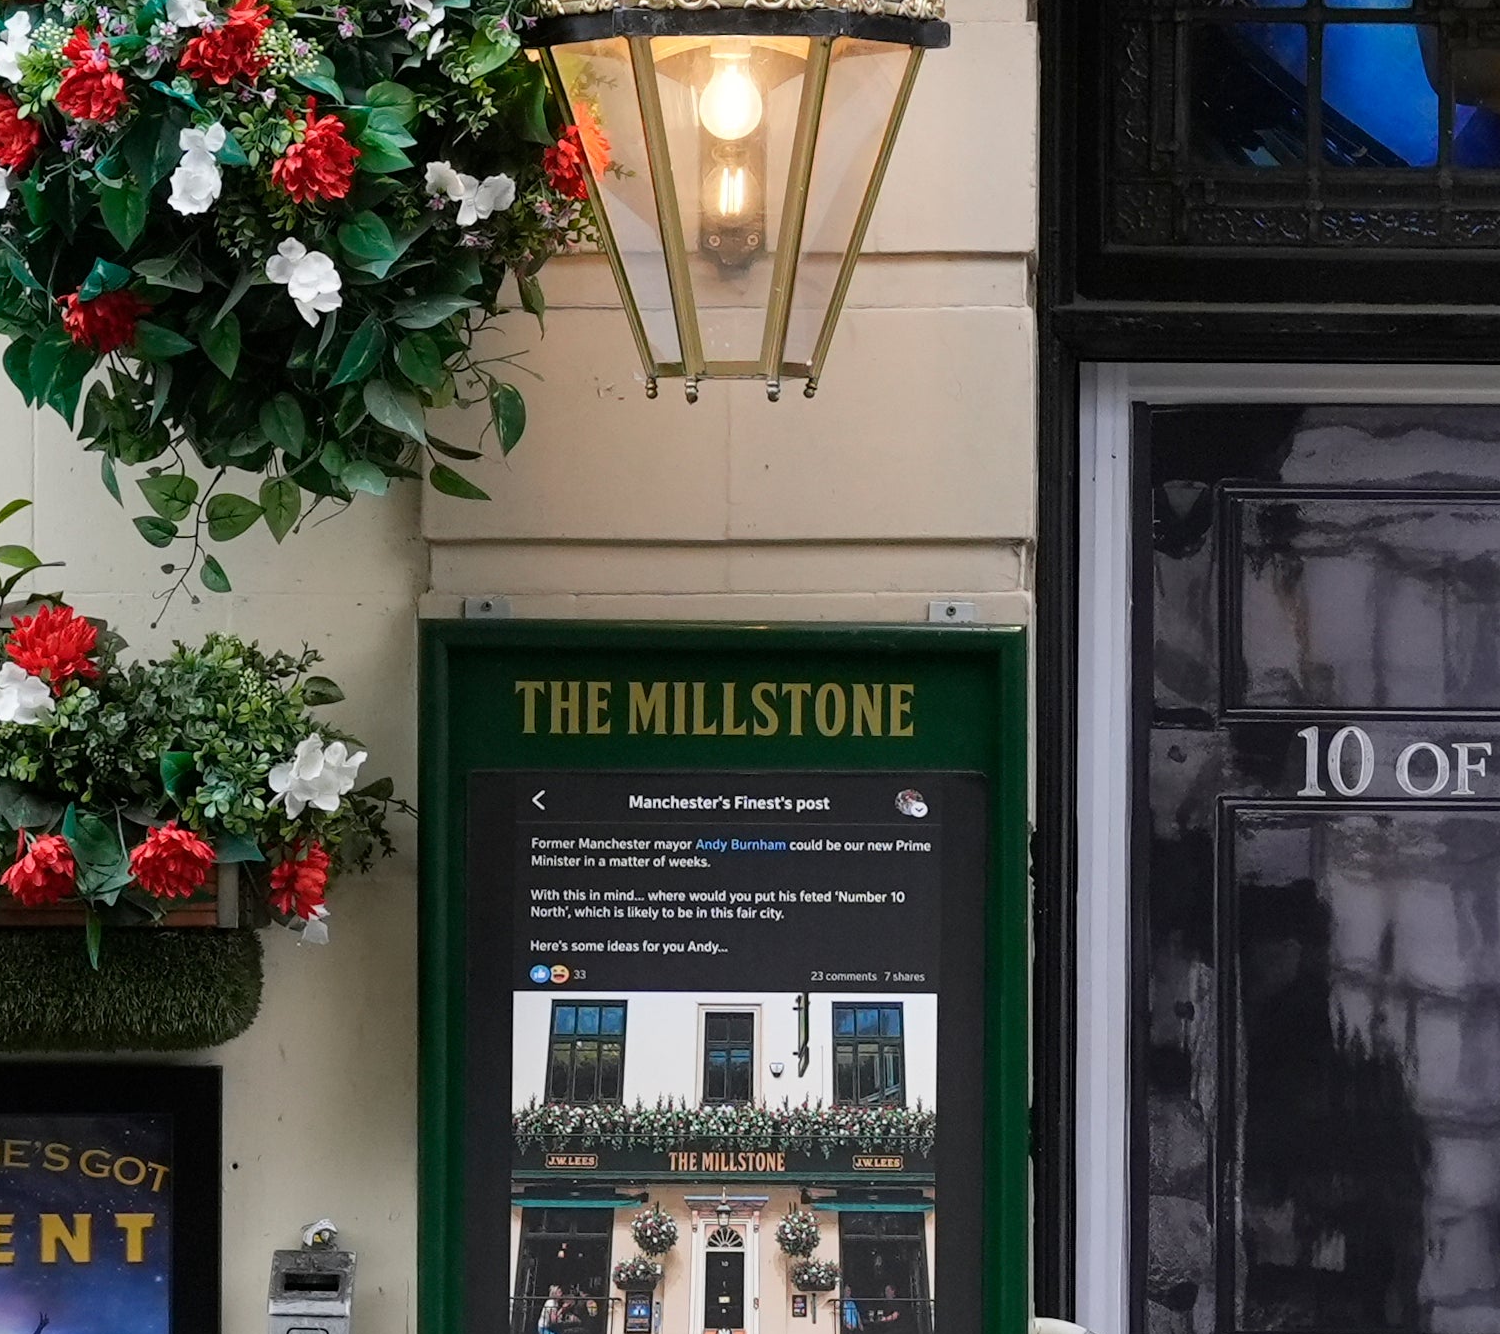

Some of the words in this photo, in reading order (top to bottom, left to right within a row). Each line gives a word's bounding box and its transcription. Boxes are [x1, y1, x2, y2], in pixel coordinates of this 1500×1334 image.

[515, 680, 612, 735] THE
[628, 681, 915, 737] MILLSTONE
[1297, 725, 1375, 798] 10
[1396, 742, 1491, 797] OF
[629, 795, 730, 810] Manchester's
[735, 796, 792, 810] Finest's
[796, 798, 831, 813] post
[531, 838, 575, 850] Former
[579, 838, 651, 850] Manchester
[654, 841, 692, 854] mayor
[695, 839, 728, 854] Andy
[731, 839, 787, 851] Burnham
[790, 839, 823, 851] could
[826, 840, 841, 851] be
[844, 842, 865, 852] our
[868, 842, 893, 852] new
[896, 840, 932, 852] Prime
[531, 855, 581, 867] Minister
[584, 855, 595, 867] in
[598, 858, 606, 867] a
[609, 857, 650, 867] matter
[653, 855, 666, 867] of
[669, 856, 711, 868] weeks.
[530, 889, 560, 901] With
[563, 889, 588, 901] this
[590, 889, 601, 901] in
[604, 889, 645, 901] mind...
[648, 890, 686, 902] where
[689, 890, 726, 902] would
[729, 893, 751, 905] you
[755, 892, 775, 905] put
[779, 890, 797, 903] his
[800, 890, 832, 903] feted
[891, 891, 905, 903] 10
[575, 906, 610, 918] which
[614, 906, 624, 918] is
[628, 906, 659, 921] likely
[662, 907, 674, 919] to
[678, 907, 693, 919] be
[697, 907, 707, 919] in
[711, 907, 733, 919] this
[737, 907, 757, 919] fair
[760, 907, 785, 922] city.
[530, 940, 568, 952] Here's
[571, 943, 604, 952] some
[608, 940, 640, 952] ideas
[643, 940, 660, 952] for
[663, 943, 685, 955] you
[687, 941, 729, 955] Andy...
[573, 969, 587, 980] 33
[810, 971, 824, 981] 23
[826, 972, 878, 982] comments
[884, 971, 891, 982] 7
[893, 971, 926, 982] shares
[669, 1152, 698, 1172] THE
[702, 1152, 786, 1172] MILLSTONE
[78, 1148, 171, 1194] GOT
